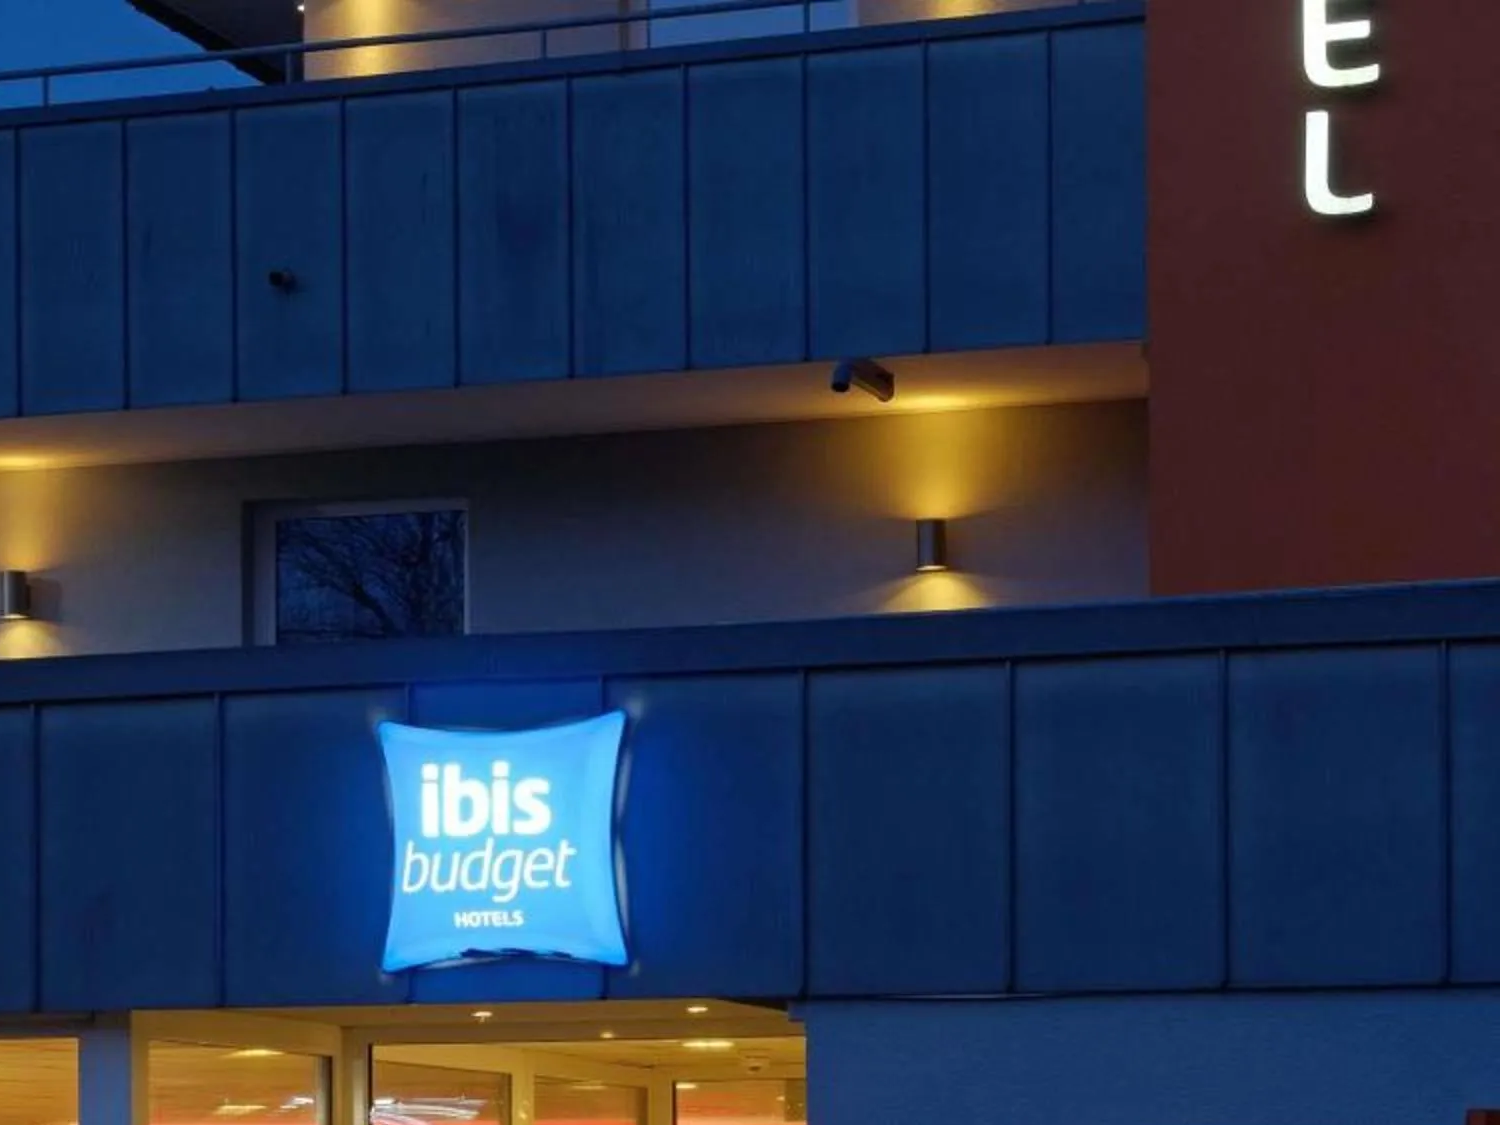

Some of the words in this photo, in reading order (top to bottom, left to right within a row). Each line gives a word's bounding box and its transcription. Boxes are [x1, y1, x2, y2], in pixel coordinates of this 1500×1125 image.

[420, 759, 552, 838] ibis
[402, 837, 577, 902] budget
[454, 910, 525, 928] HOTELS
